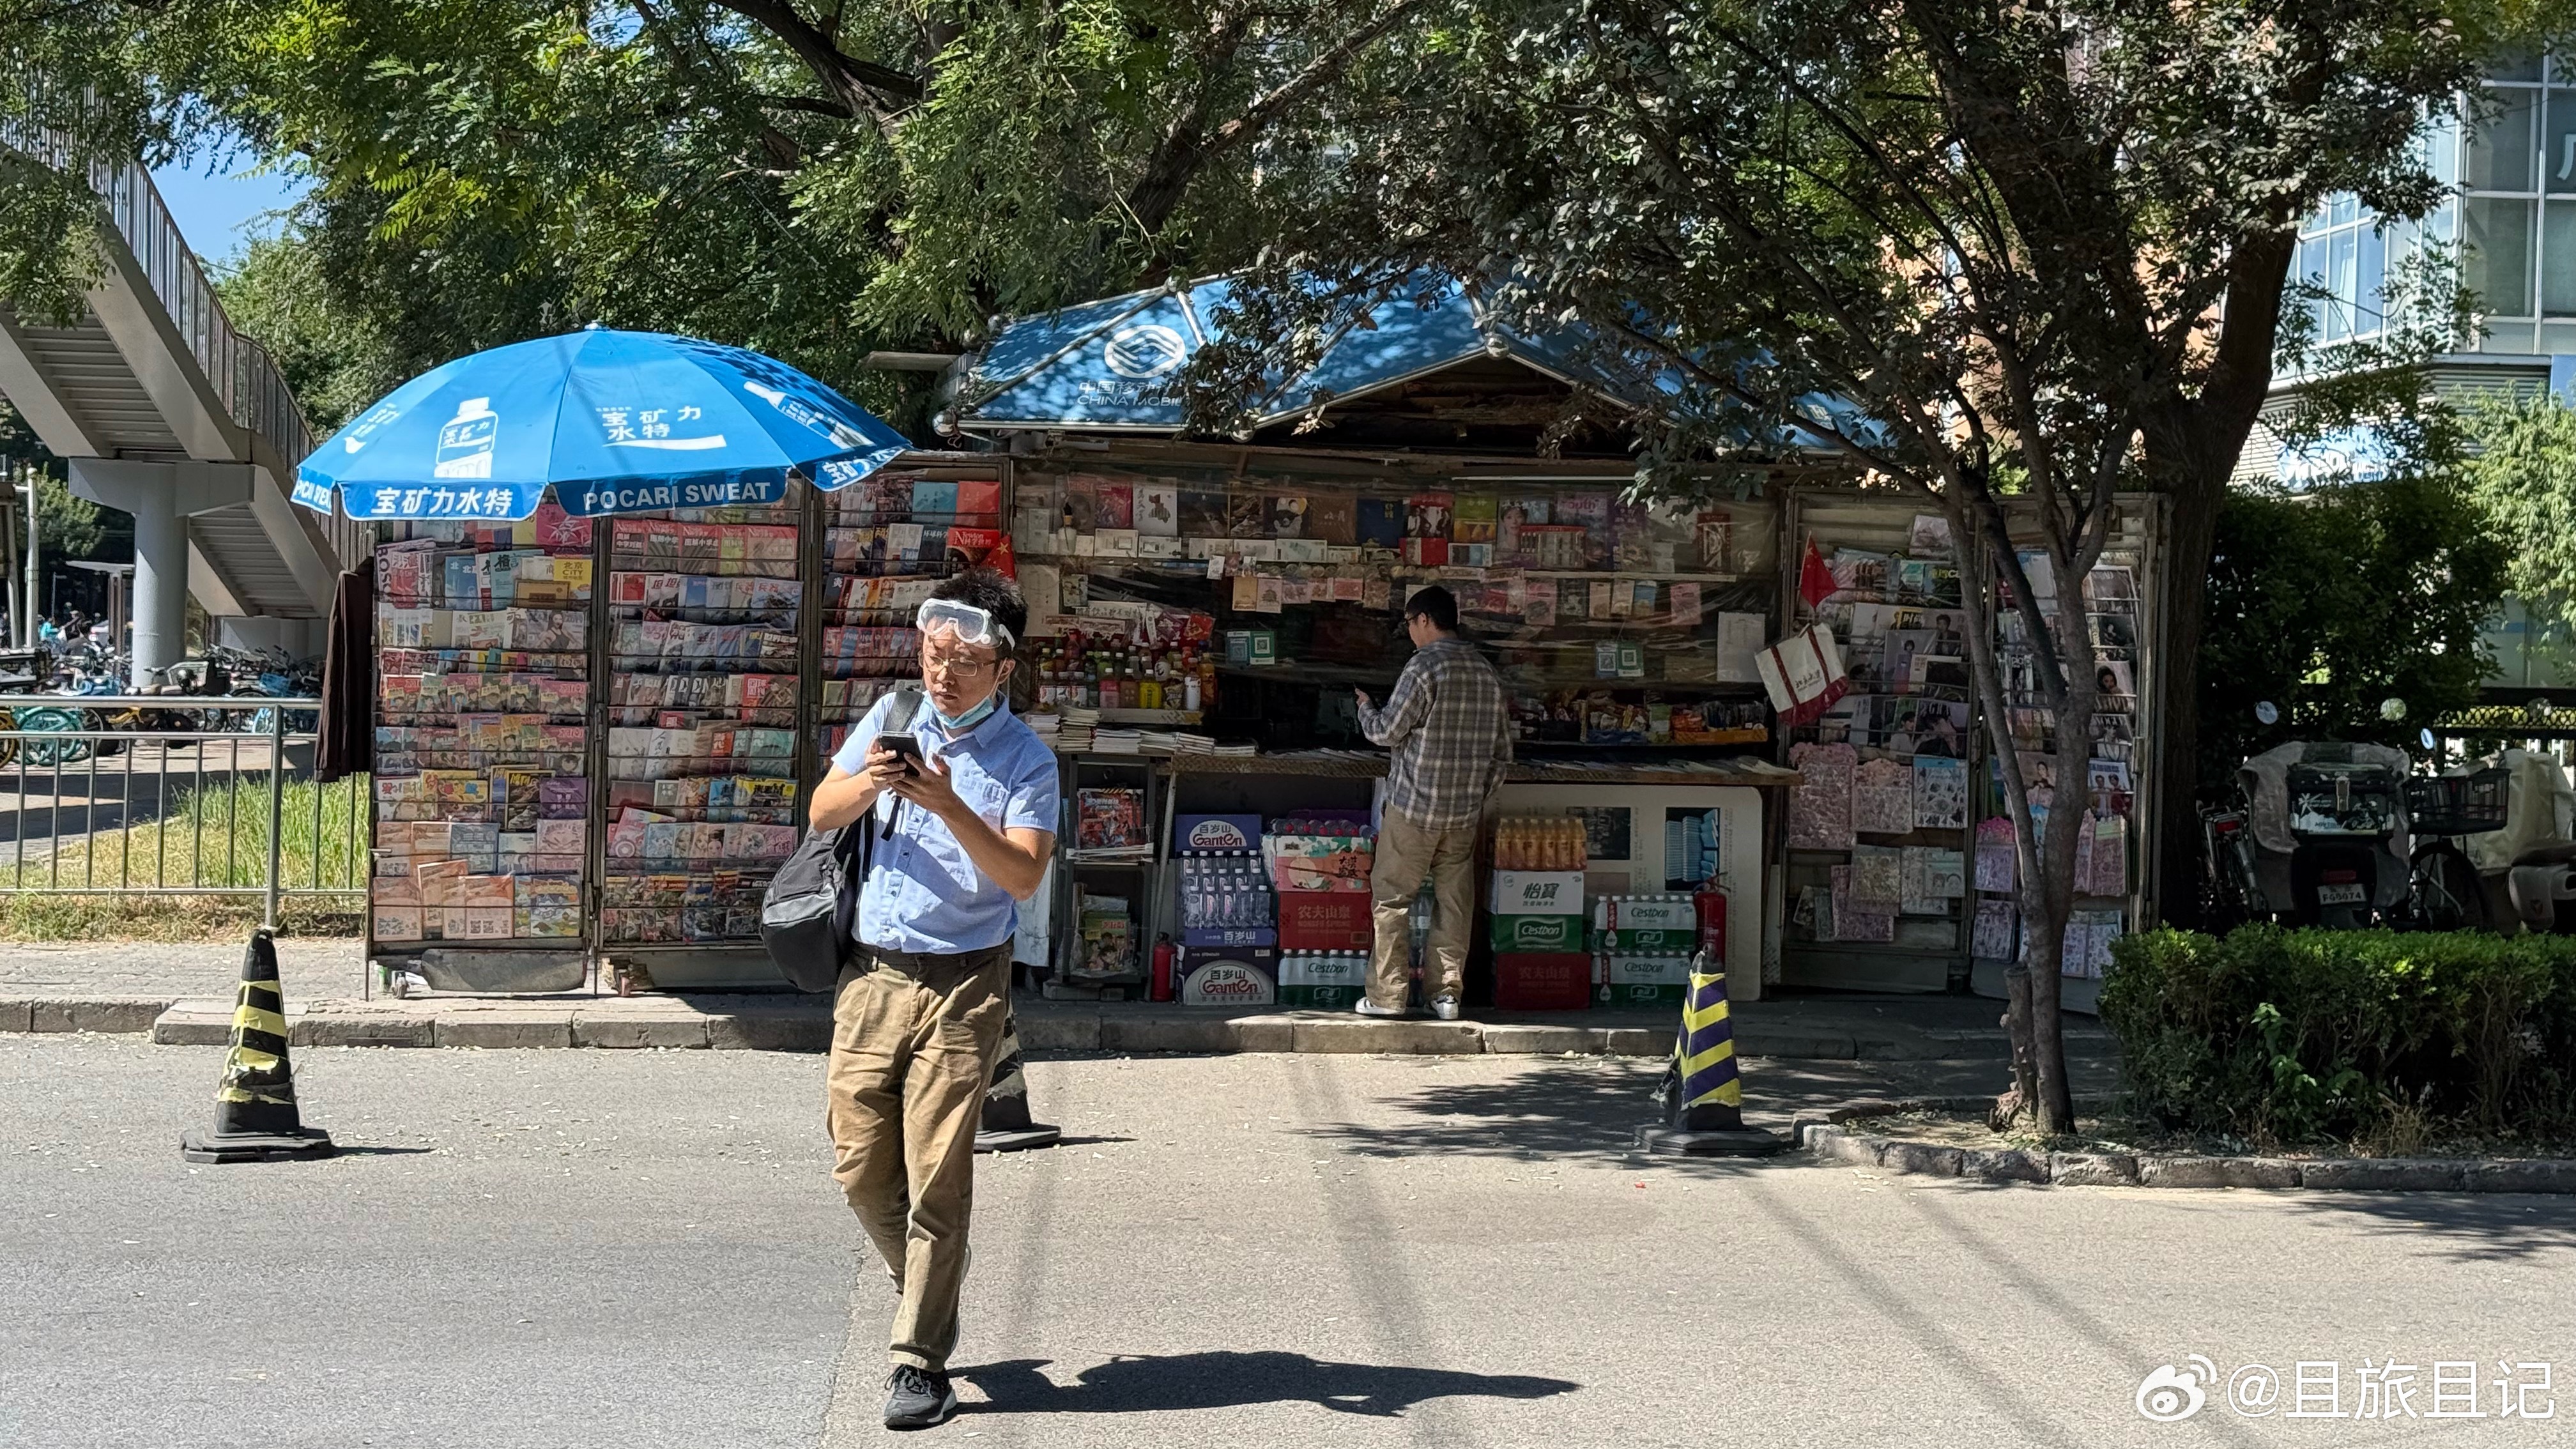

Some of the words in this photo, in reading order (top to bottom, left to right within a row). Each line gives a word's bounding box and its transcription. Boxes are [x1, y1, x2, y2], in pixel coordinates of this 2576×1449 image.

[1078, 381, 1182, 395] 中国移动
[1077, 395, 1128, 406] CHINA
[1133, 396, 1183, 407] MOBIL
[602, 406, 702, 427] 宝矿力
[608, 423, 670, 441] 水特
[371, 487, 513, 516] 宝矿力水特
[583, 486, 679, 511] POCARI
[685, 482, 770, 503] SWEAT
[1200, 824, 1231, 834] 百岁山
[1298, 905, 1350, 919] 农夫山泉
[1631, 907, 1669, 918] Cestbon
[1224, 931, 1255, 940] 百岁山
[1521, 925, 1560, 935] Cestbon
[1308, 962, 1349, 974] Cestbon
[1625, 962, 1664, 973] Cestbon
[1211, 970, 1245, 979] 百岁山
